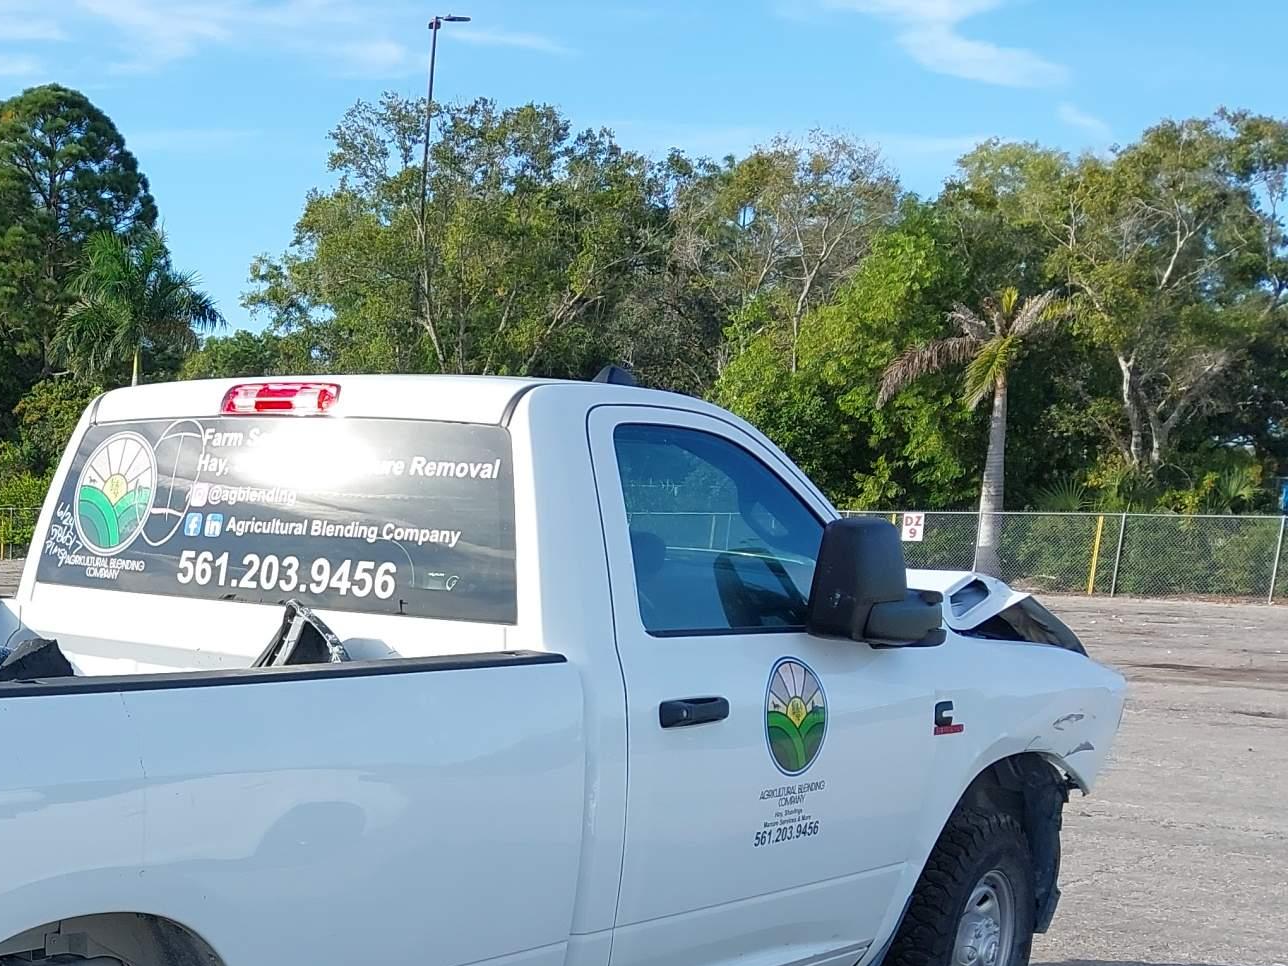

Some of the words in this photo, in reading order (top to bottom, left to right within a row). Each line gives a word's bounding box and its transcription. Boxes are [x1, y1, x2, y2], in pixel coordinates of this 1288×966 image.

[203, 428, 244, 447] Farm
[197, 453, 230, 477] Hay,
[409, 456, 501, 479] Removal
[208, 485, 297, 506] @agblending
[226, 516, 308, 536] Agricultural
[311, 520, 379, 543] Blending
[382, 523, 462, 547] Company
[905, 516, 923, 527] DZ
[908, 528, 917, 539] 9
[64, 554, 109, 569] AGRICULTURAL
[109, 558, 145, 572] BLENDING
[85, 567, 120, 580] COMPANY
[176, 549, 397, 599] 561.203.9456
[759, 784, 798, 800] AGRICULTURAL
[797, 780, 825, 795] BLENDING
[778, 794, 806, 807] COMPANY
[754, 820, 820, 847] 561.203.9456
